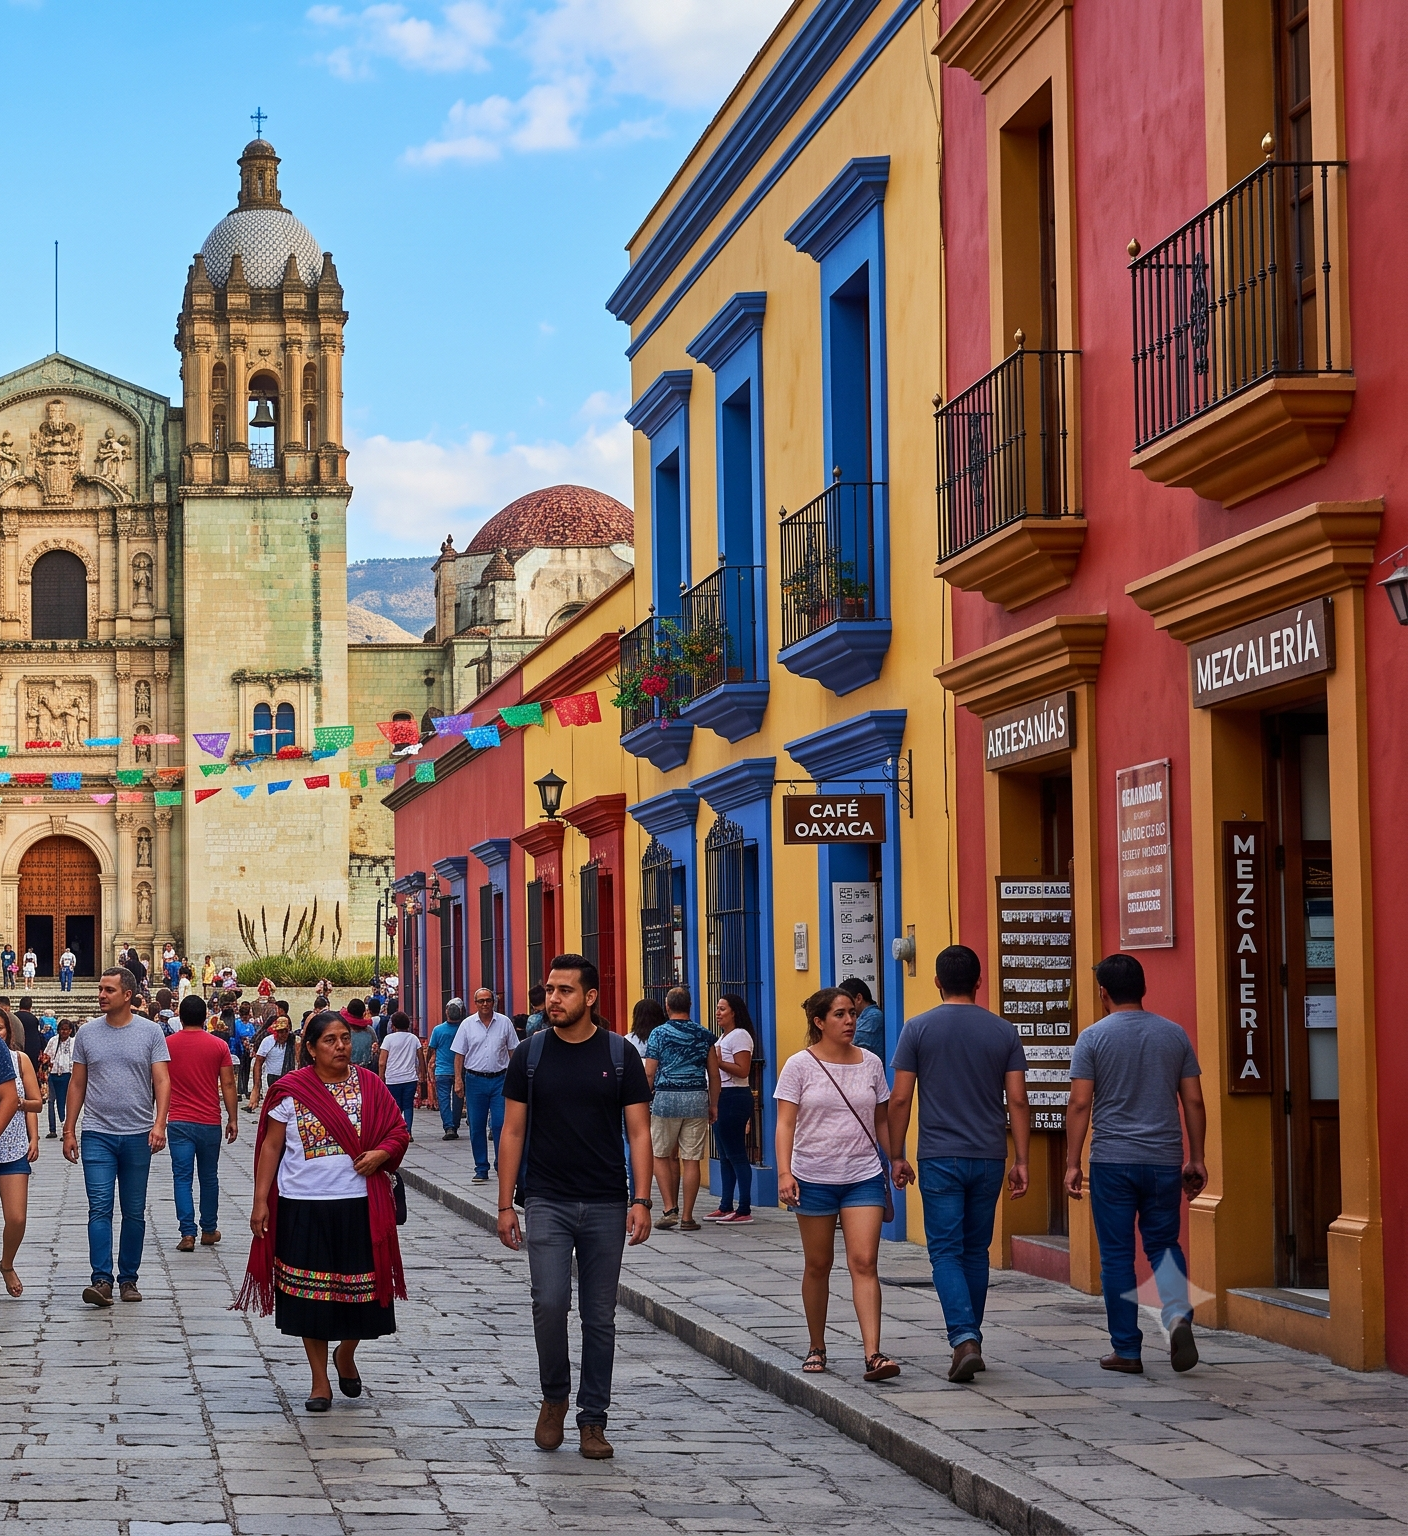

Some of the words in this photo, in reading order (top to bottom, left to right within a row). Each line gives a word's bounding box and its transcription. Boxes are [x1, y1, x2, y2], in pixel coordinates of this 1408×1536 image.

[1196, 609, 1320, 695] MEZCALERÍA
[986, 700, 1066, 760] ARTESANÍAS
[794, 821, 875, 838] OAXACA
[809, 799, 859, 818] CAFÉ
[1233, 834, 1261, 1079] MEZCALERÍA
